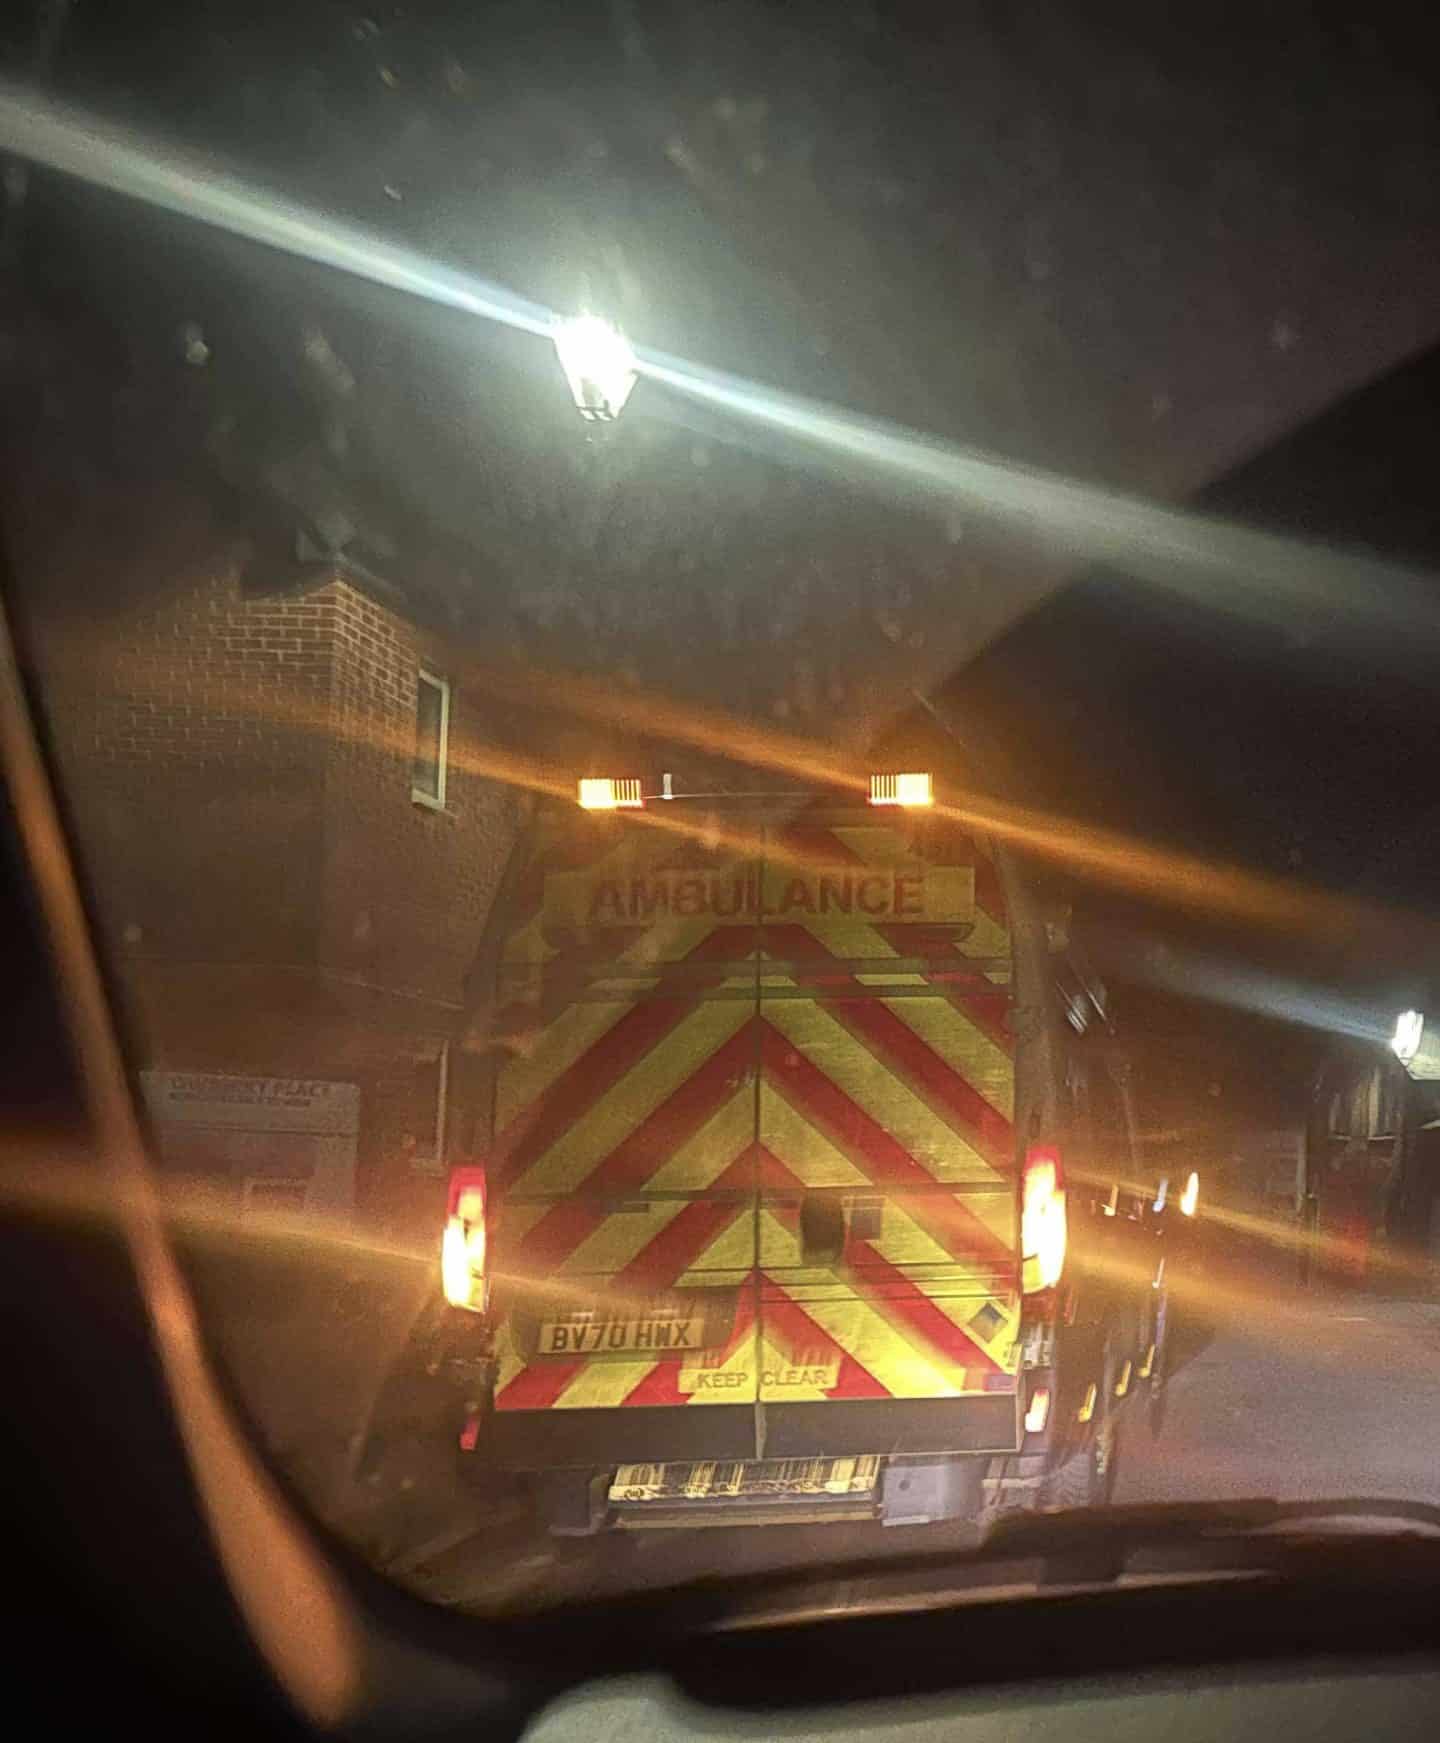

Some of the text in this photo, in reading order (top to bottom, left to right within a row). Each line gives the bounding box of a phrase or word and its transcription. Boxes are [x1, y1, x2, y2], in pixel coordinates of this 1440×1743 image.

[595, 870, 927, 917] AMBULANCE
[551, 1320, 692, 1351] BV70 HWX
[696, 1369, 829, 1389] KEEP CLEAR
